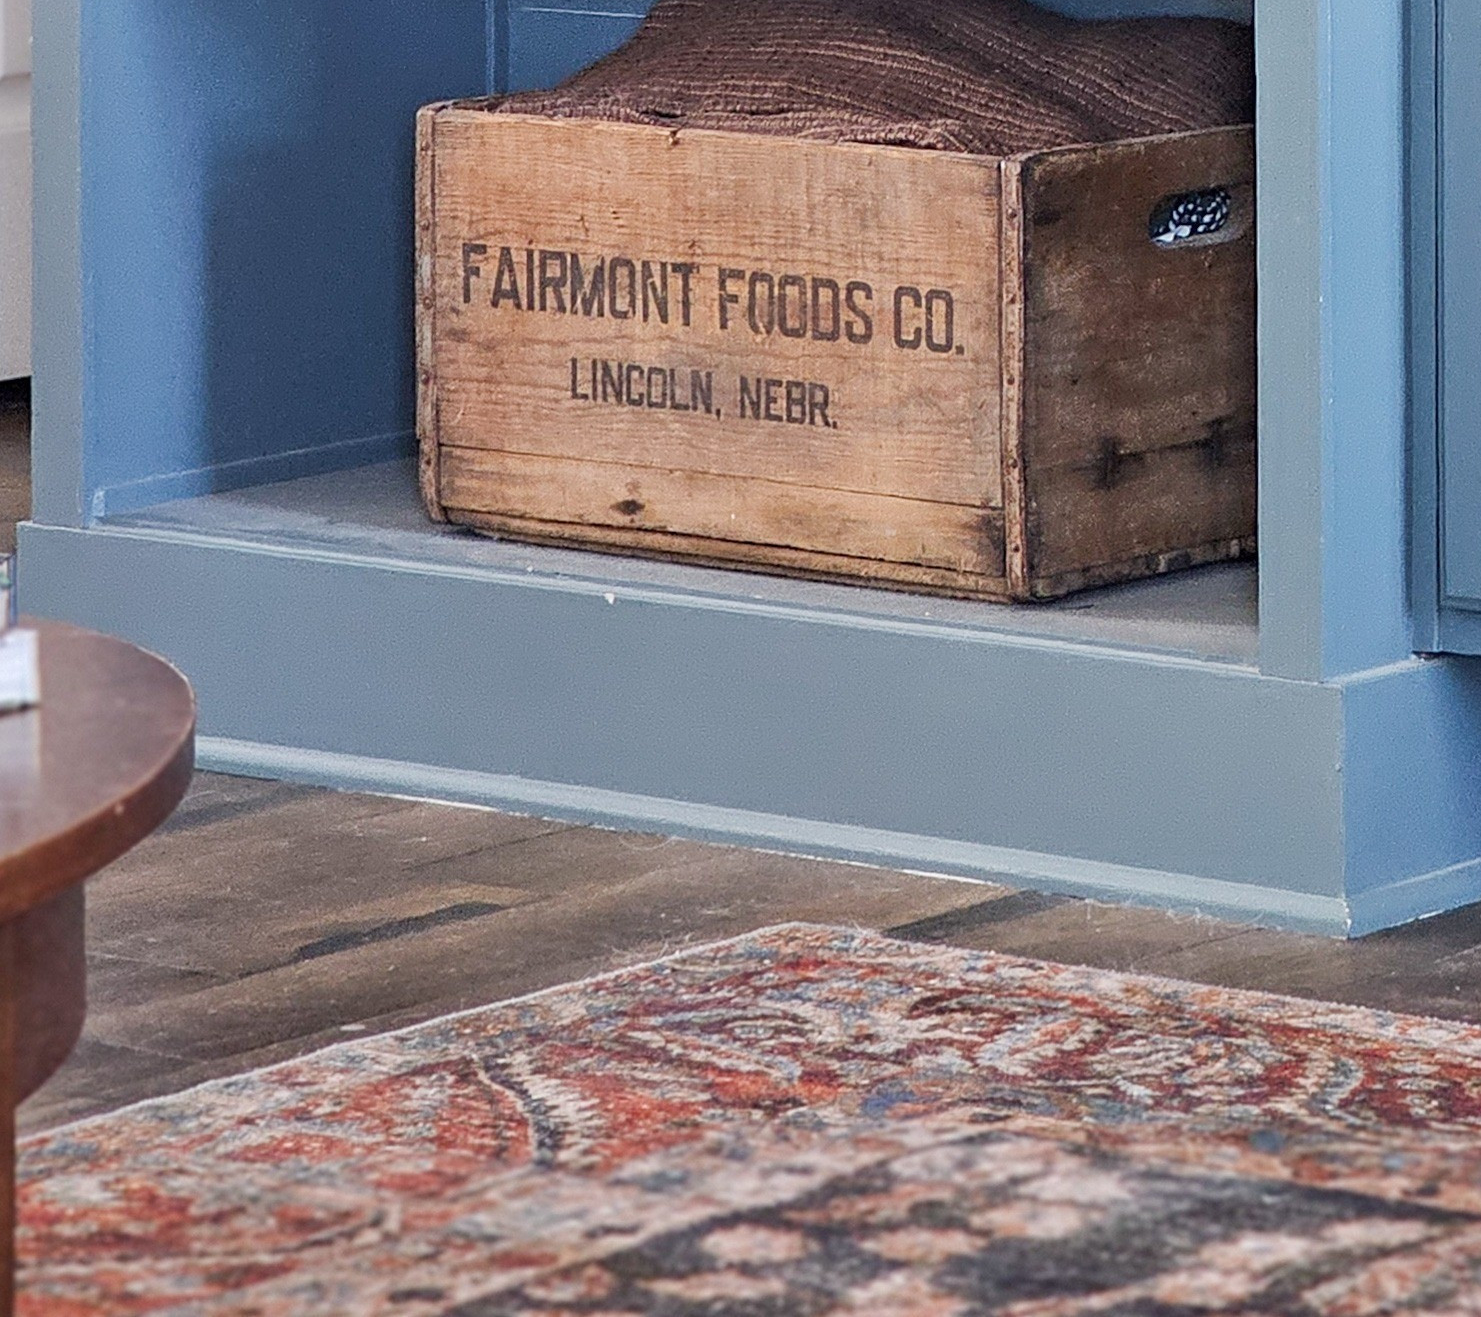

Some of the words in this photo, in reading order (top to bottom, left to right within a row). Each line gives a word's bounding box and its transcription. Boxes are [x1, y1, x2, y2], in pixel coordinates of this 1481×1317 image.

[461, 242, 700, 327] FAIRMONT
[717, 267, 873, 344] FOODS
[893, 286, 965, 355] CO.
[571, 357, 721, 421] LINCOLN,
[739, 375, 838, 429] NEBR.
